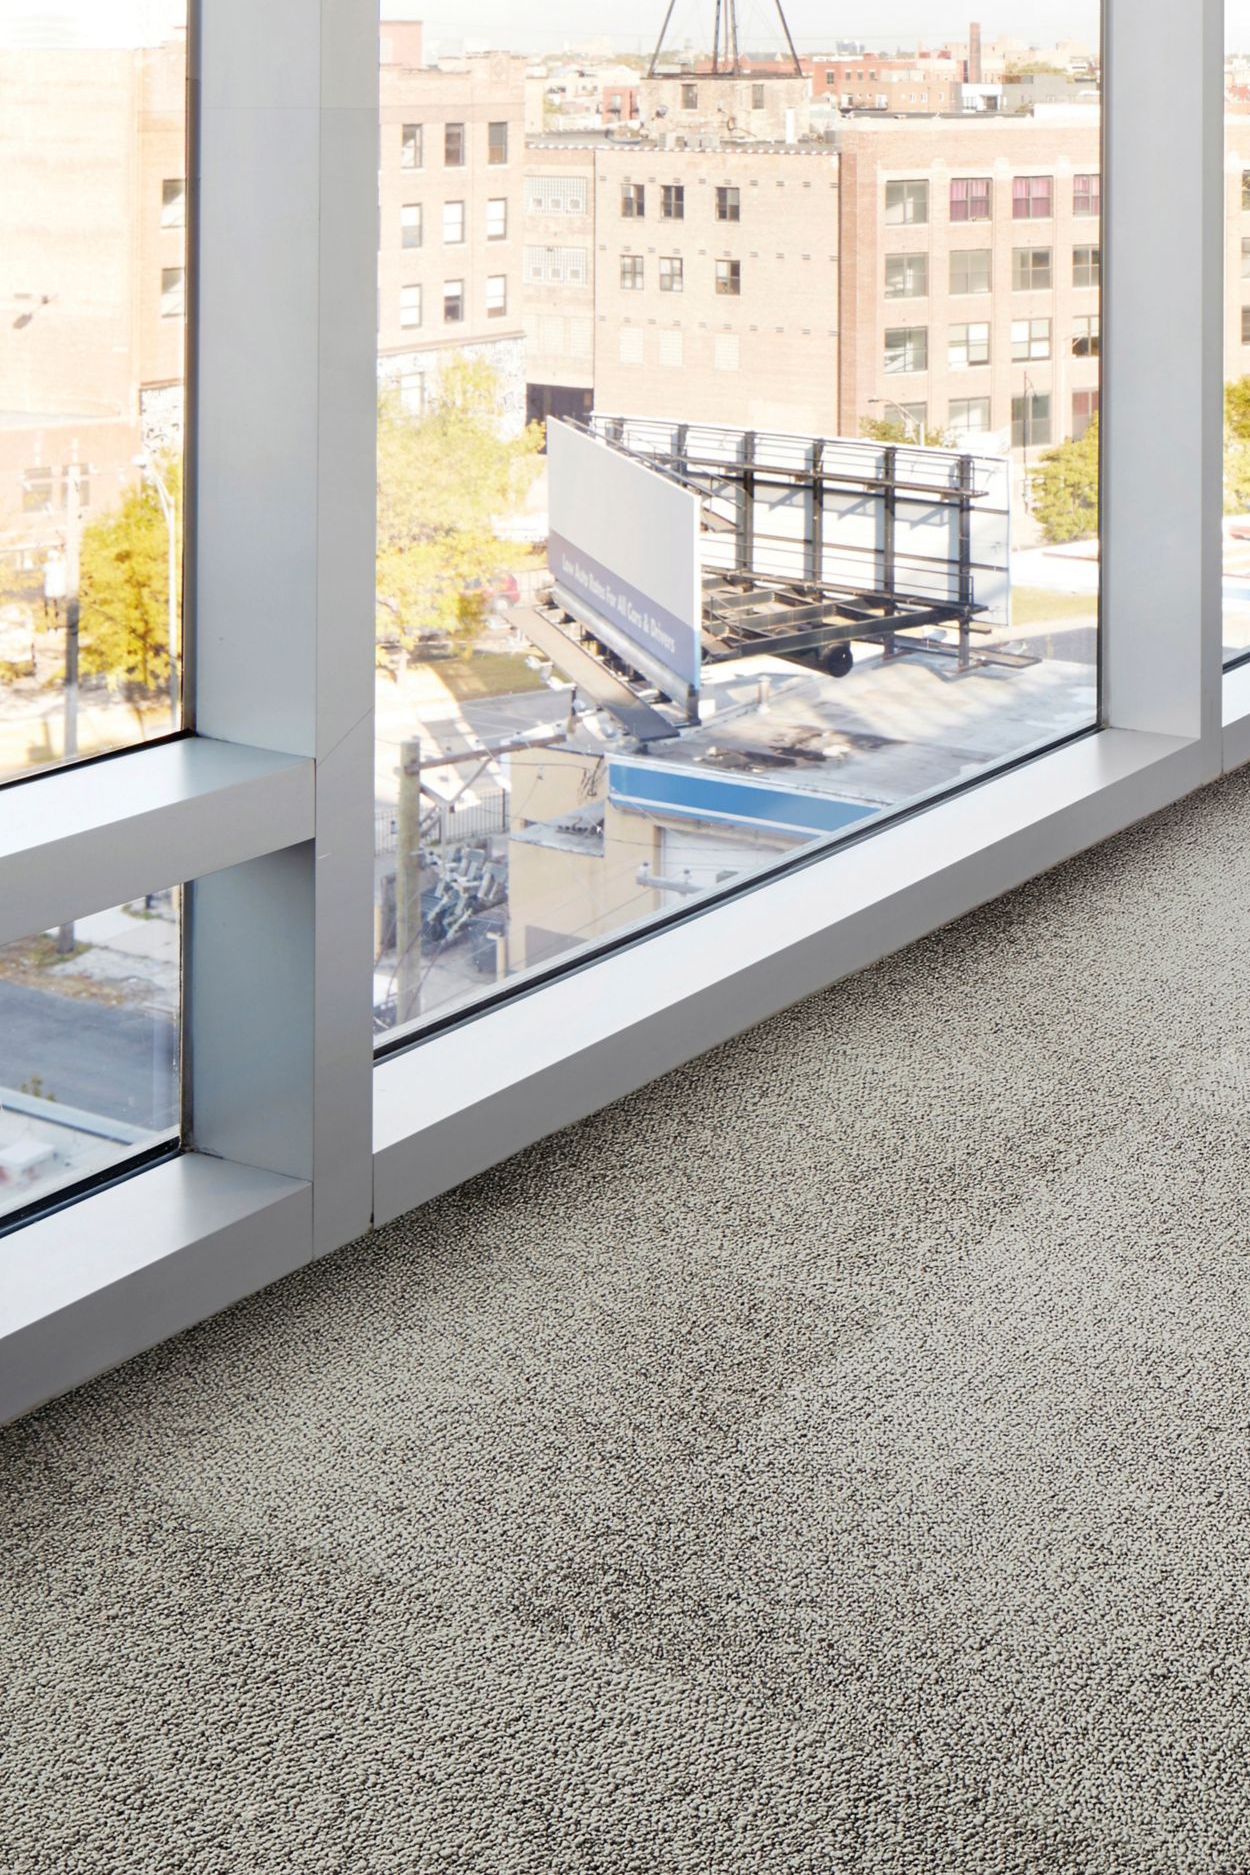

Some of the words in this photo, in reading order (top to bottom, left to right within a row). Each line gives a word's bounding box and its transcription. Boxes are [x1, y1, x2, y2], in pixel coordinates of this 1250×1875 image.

[606, 585, 617, 608] For
[617, 594, 626, 616] All
[628, 601, 642, 628] Cars
[643, 613, 649, 633] &
[650, 618, 675, 653] Drivers
